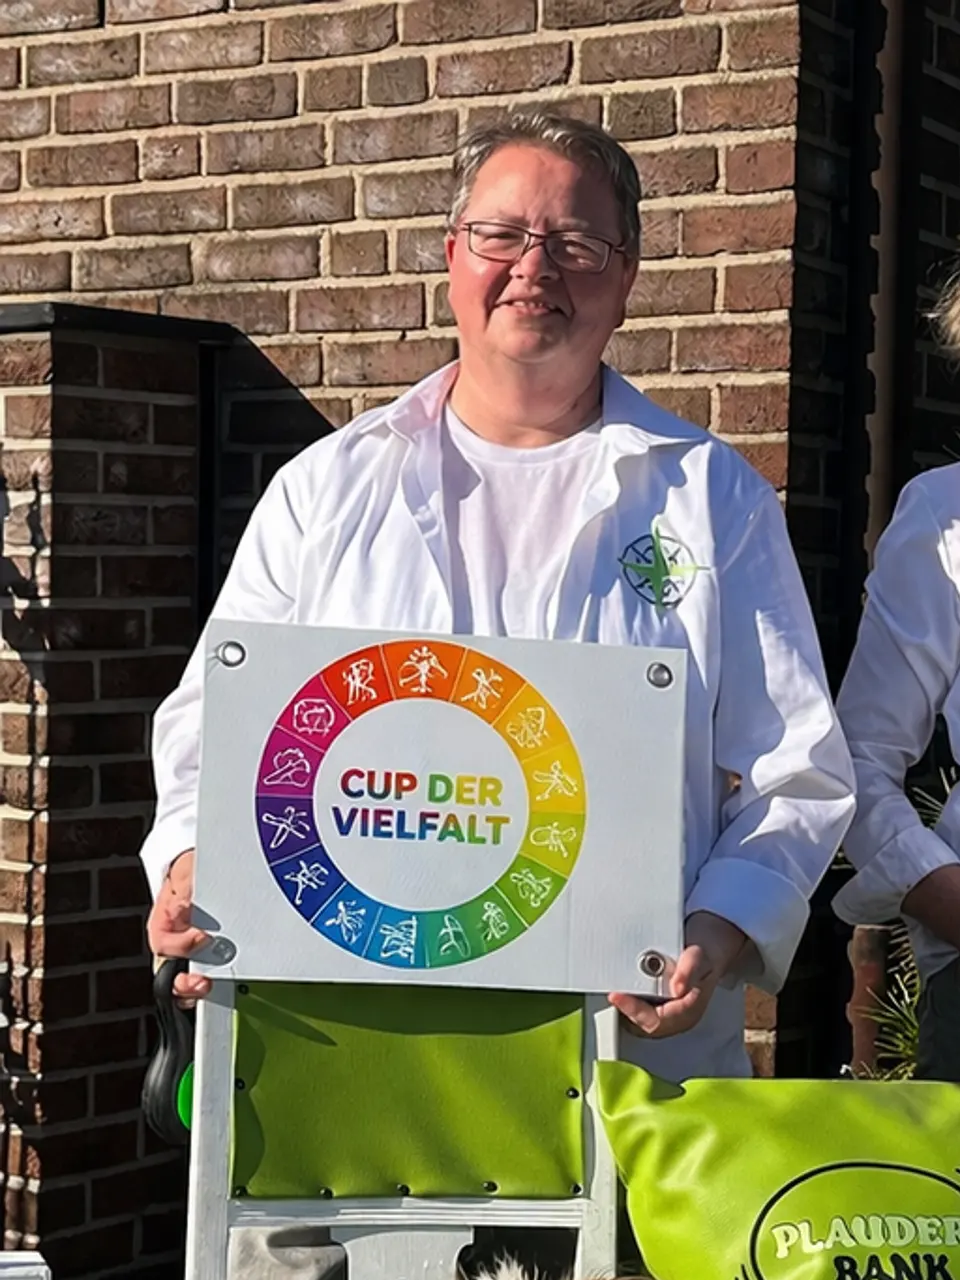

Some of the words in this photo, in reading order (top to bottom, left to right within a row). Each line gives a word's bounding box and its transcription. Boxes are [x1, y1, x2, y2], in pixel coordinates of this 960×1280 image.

[340, 768, 418, 801] CUP
[427, 774, 503, 806] DER
[331, 806, 510, 845] VIELFALT
